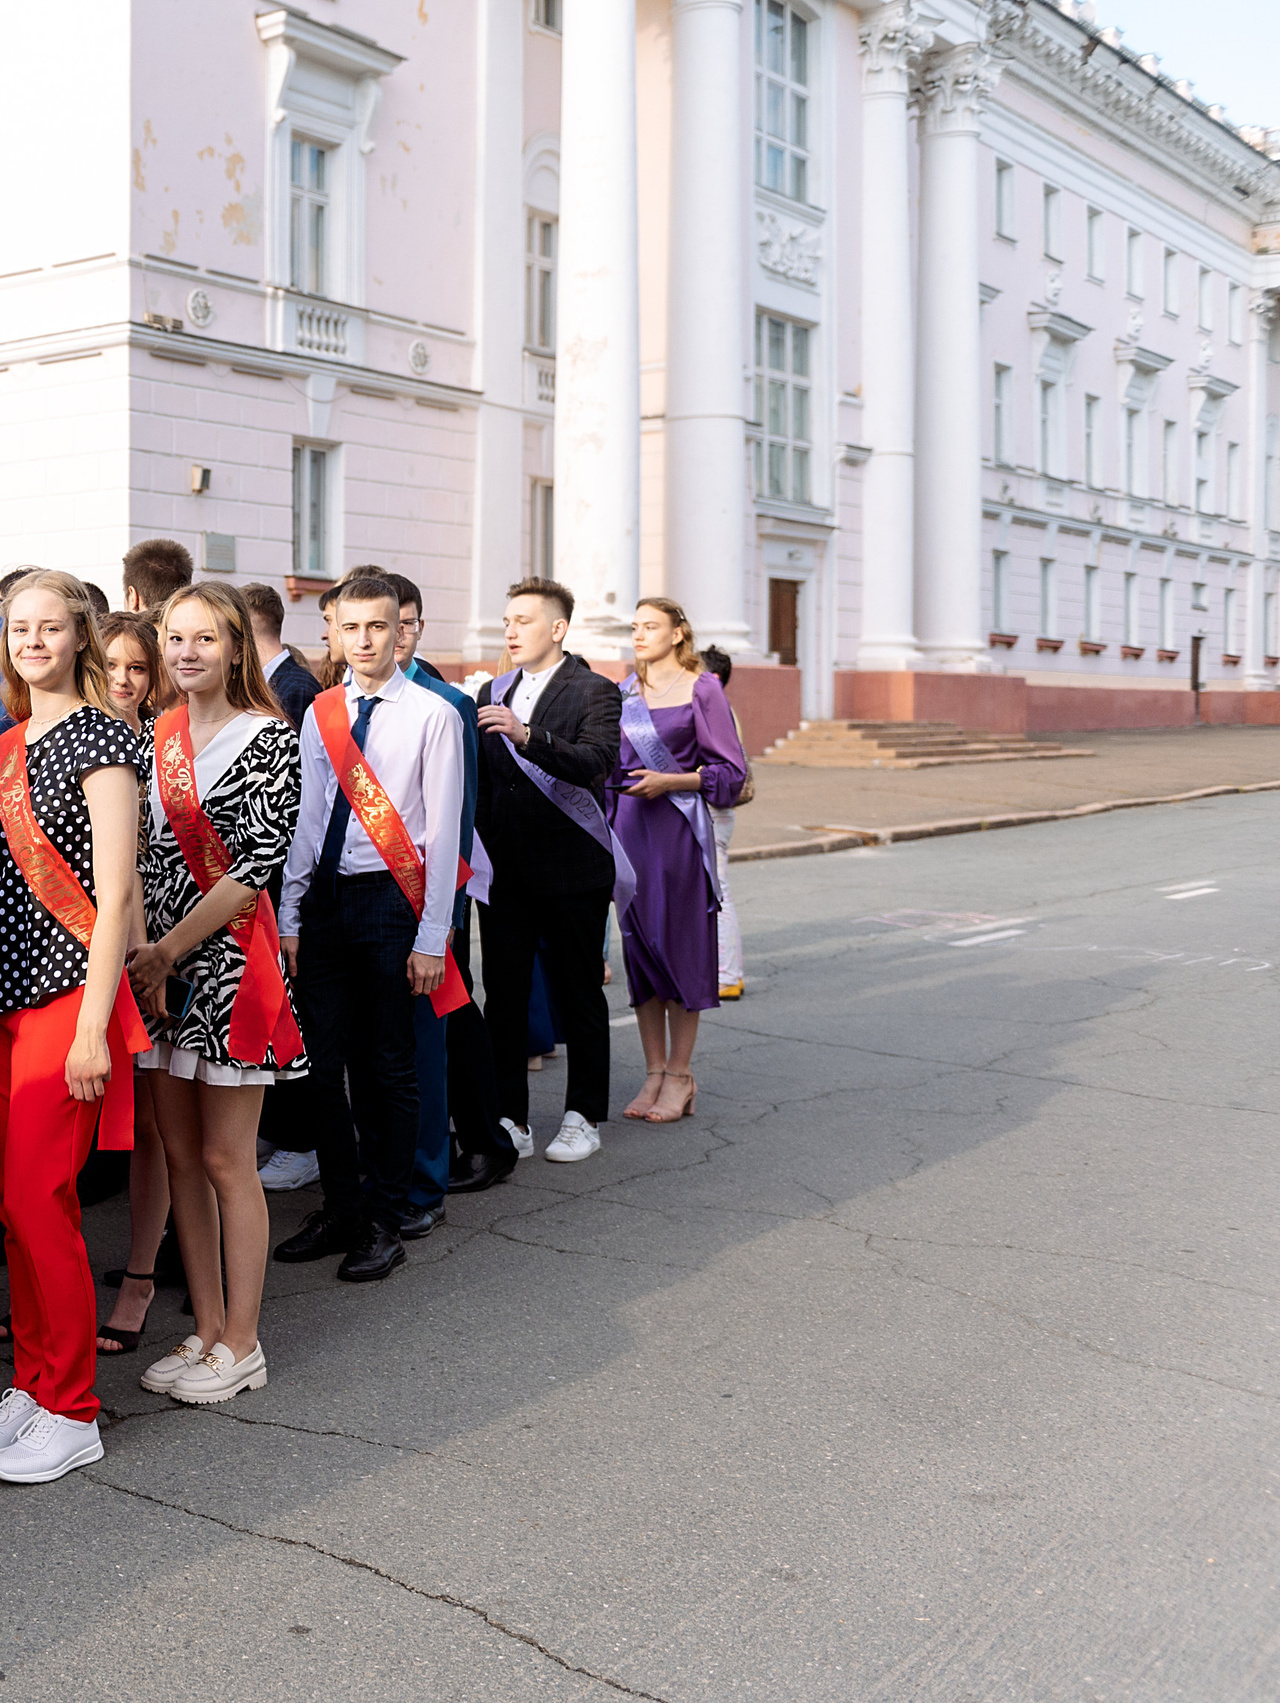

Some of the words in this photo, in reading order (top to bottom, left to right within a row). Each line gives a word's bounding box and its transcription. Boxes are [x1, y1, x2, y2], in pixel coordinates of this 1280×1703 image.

[2, 777, 73, 905] Выпускник
[165, 767, 224, 886] Выпускни
[560, 785, 597, 820] 2022
